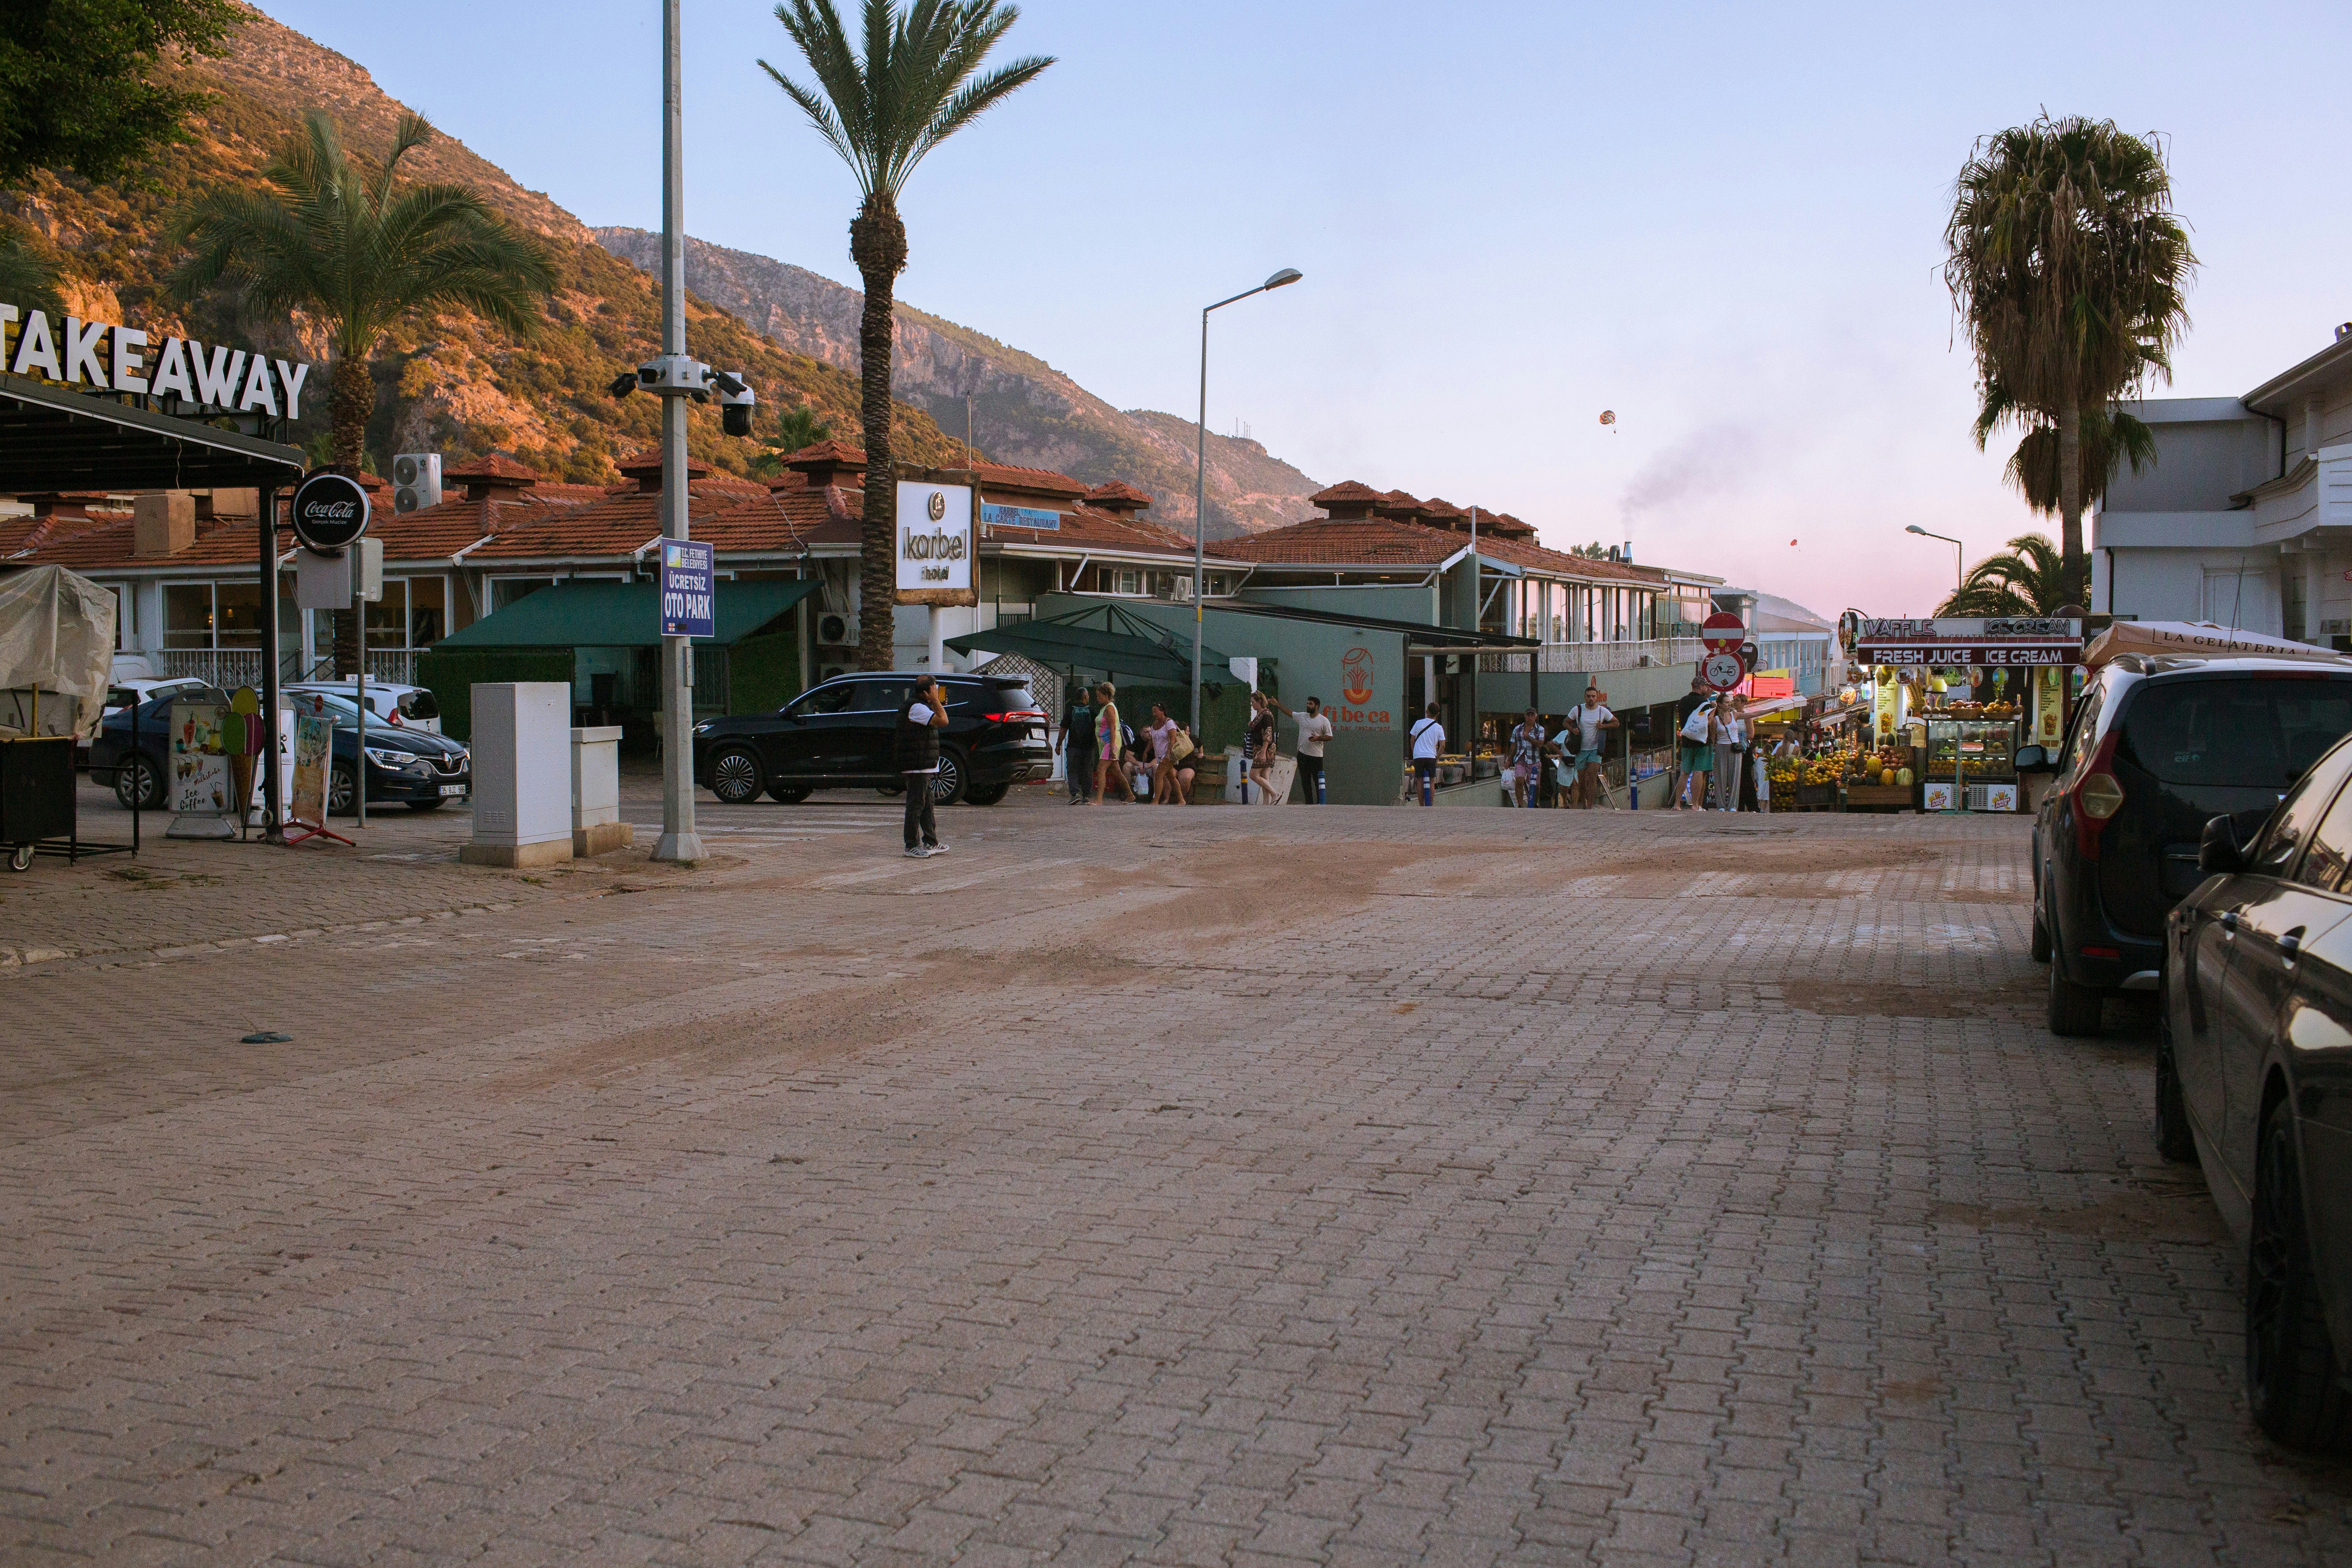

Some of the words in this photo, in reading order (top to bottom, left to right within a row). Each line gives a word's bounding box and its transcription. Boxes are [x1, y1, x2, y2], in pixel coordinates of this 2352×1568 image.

[0, 303, 309, 419] TAKEAWAY
[305, 501, 357, 518] Coca-Cola
[984, 513, 992, 523] LA
[995, 514, 1016, 525] CARTE
[1019, 516, 1057, 528] RESTAURANT
[903, 526, 967, 560] karbel
[922, 565, 949, 581] hotel
[665, 592, 684, 618] OTO
[686, 594, 711, 619] PARK
[1863, 619, 1937, 637] WAFFLE
[1984, 619, 2010, 633] ICE
[2013, 619, 2070, 636] CREAM
[2163, 632, 2185, 643] LA
[2194, 635, 2296, 654] GELATERIA
[1873, 650, 1924, 663] FRESH
[1928, 649, 1972, 663] JUICE
[1985, 650, 2007, 663] ICE
[2010, 650, 2063, 663] CREAM
[185, 789, 200, 800] Ice
[180, 797, 207, 811] Coffee
